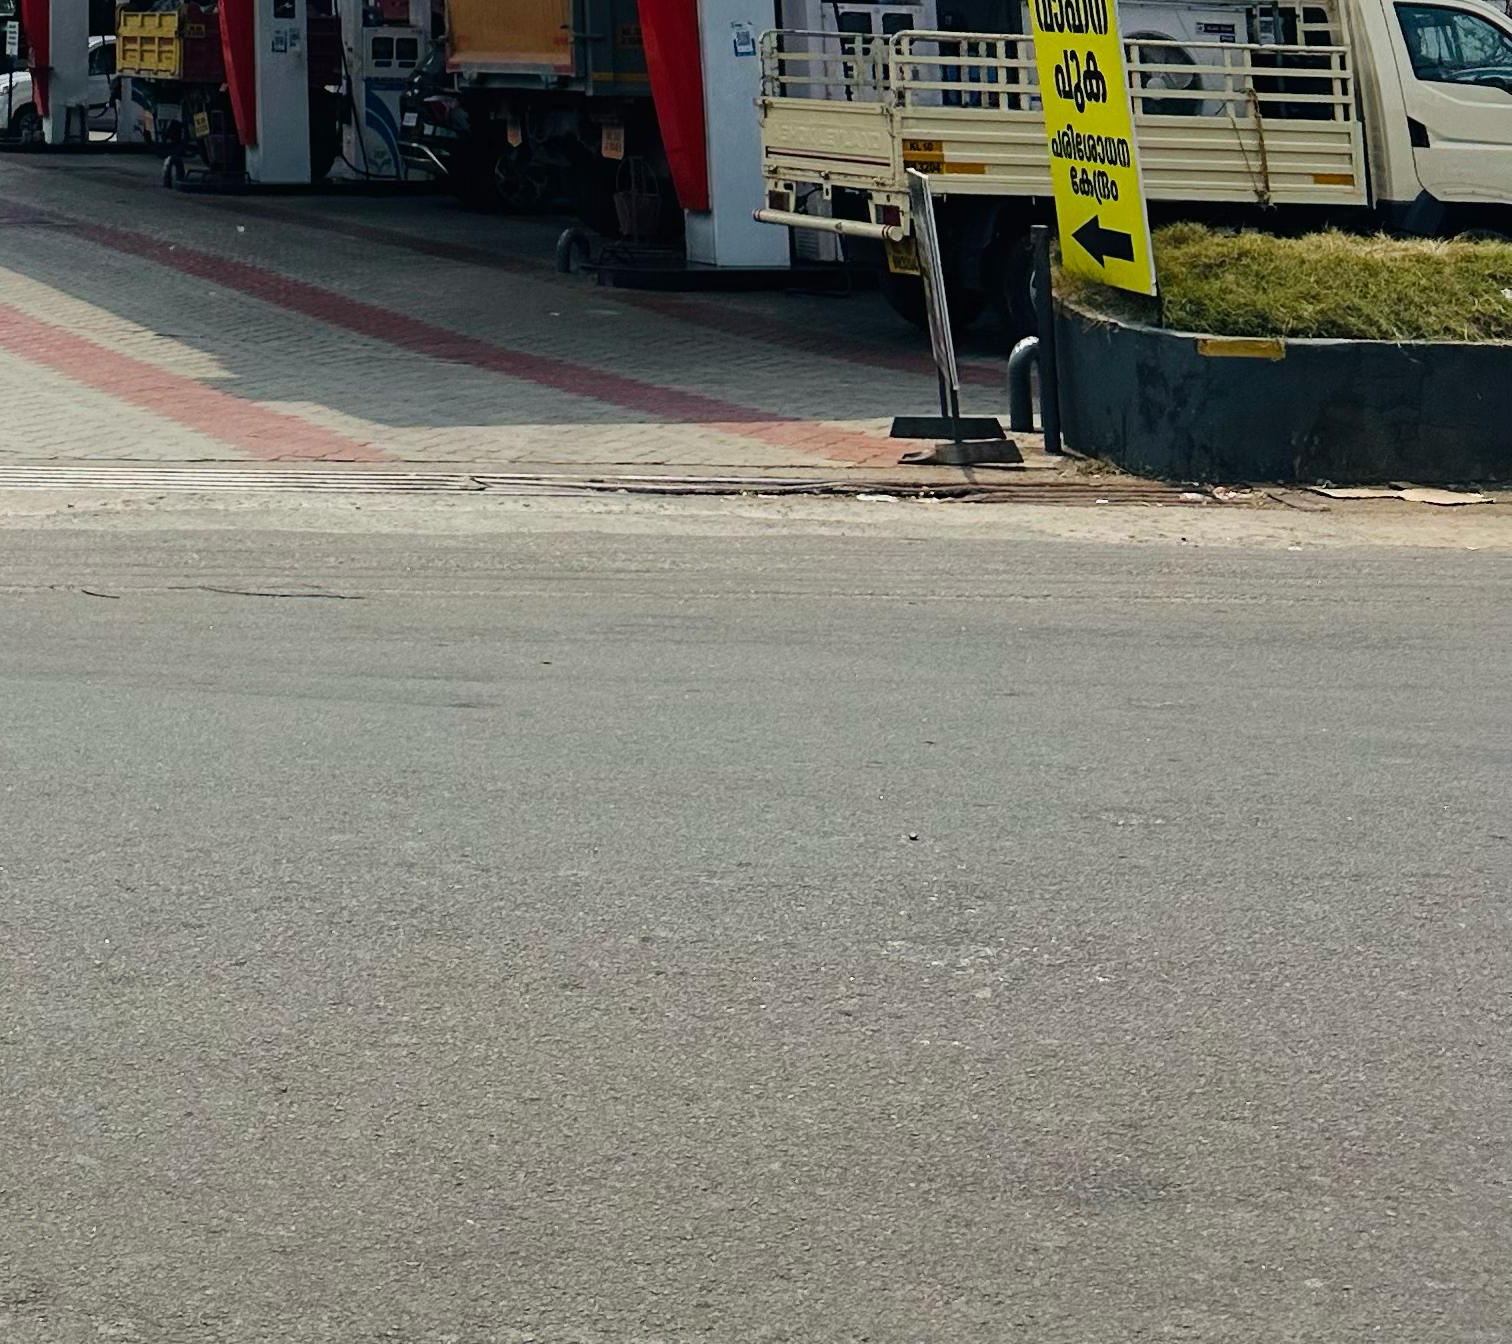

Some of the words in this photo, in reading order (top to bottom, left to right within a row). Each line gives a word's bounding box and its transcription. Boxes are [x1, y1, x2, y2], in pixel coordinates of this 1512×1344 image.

[1054, 49, 1107, 114] പുക
[909, 141, 922, 152] KL
[1052, 123, 1131, 168] പരിശോധന
